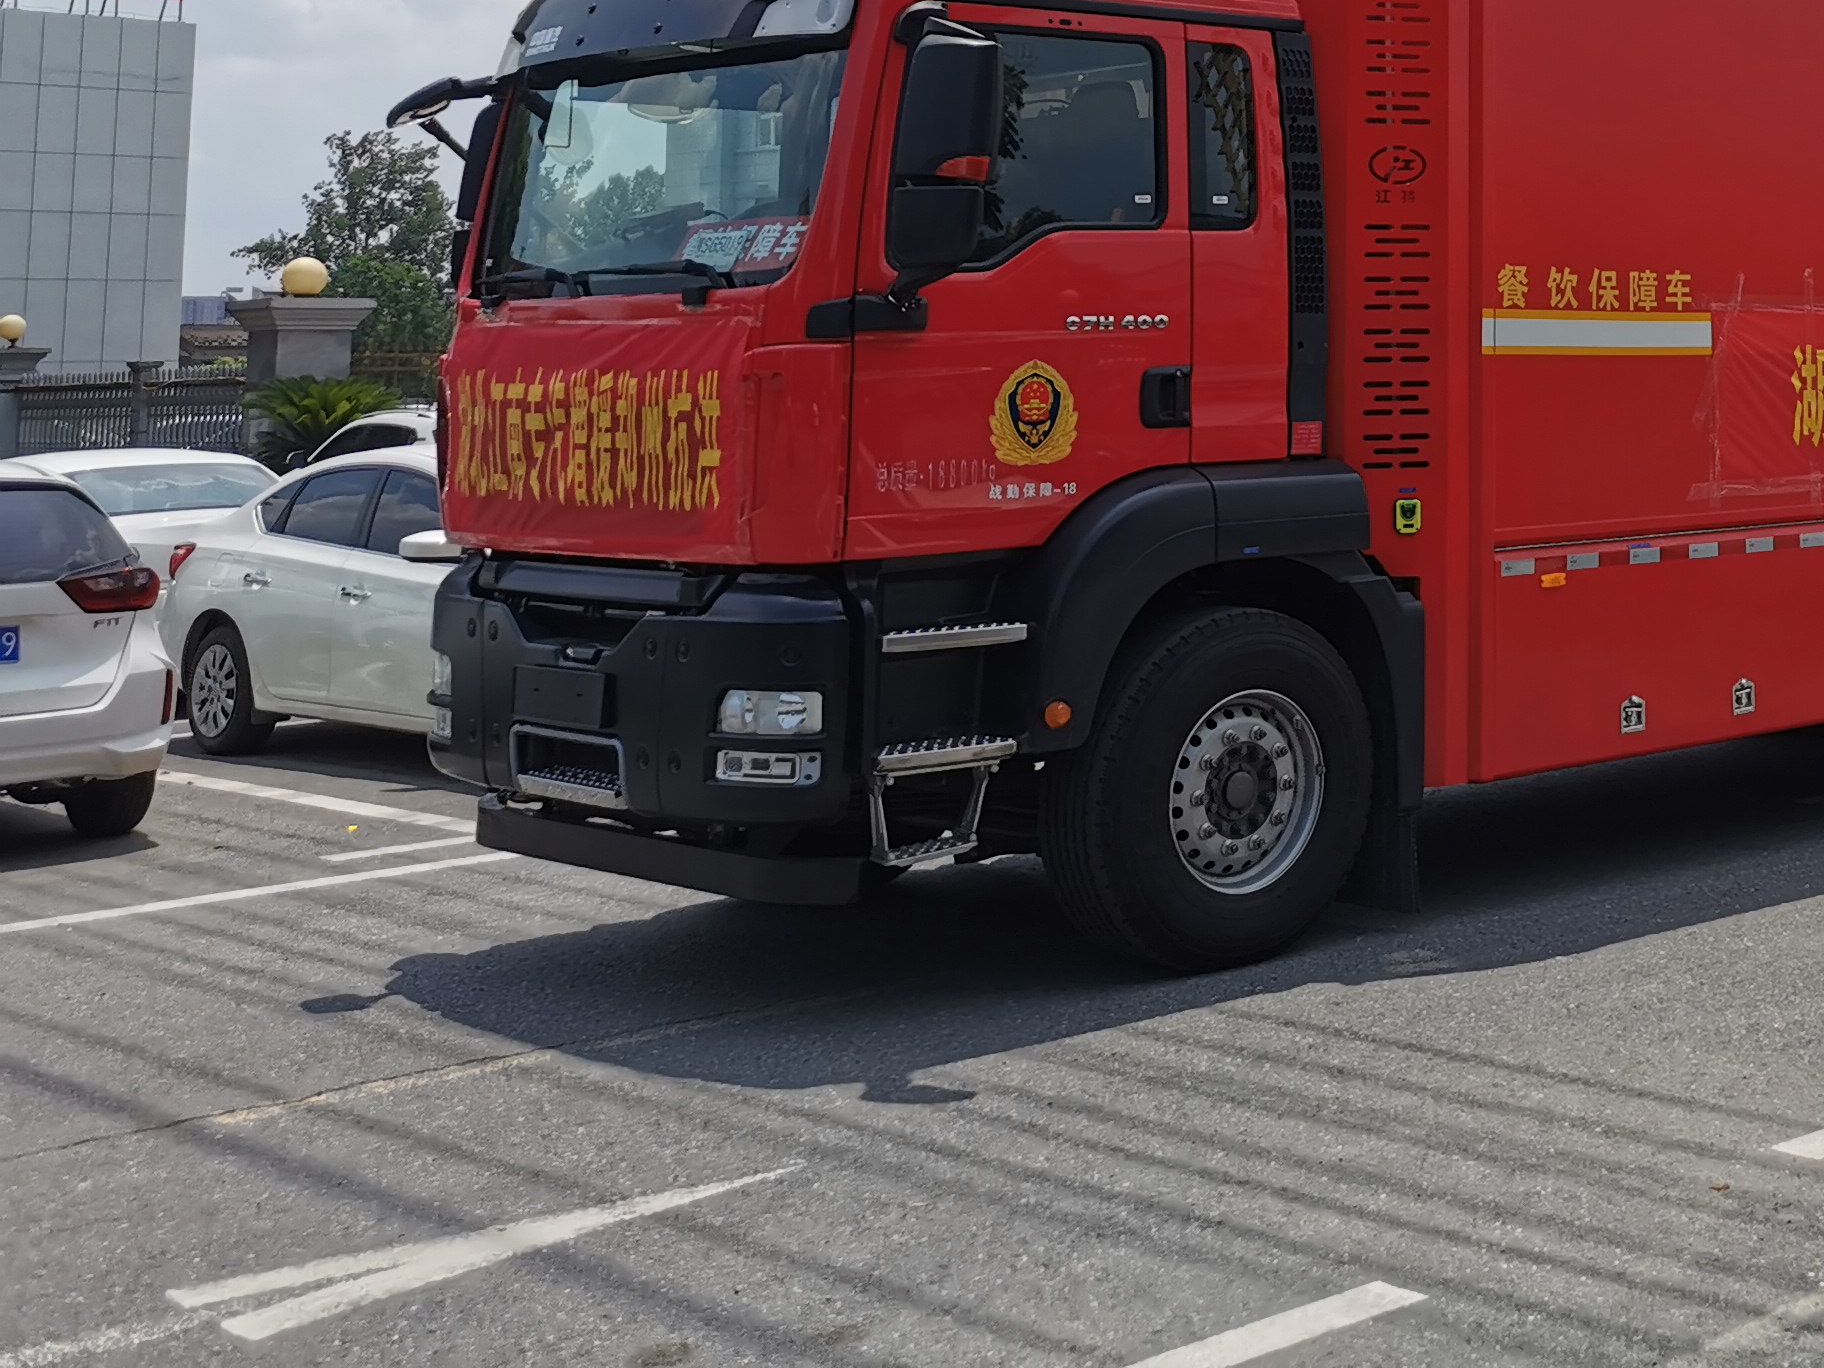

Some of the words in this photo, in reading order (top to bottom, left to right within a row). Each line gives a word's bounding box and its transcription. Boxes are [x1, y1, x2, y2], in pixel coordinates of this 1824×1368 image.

[1497, 263, 1693, 312] 餐饮保障车
[1120, 314, 1169, 330] 400
